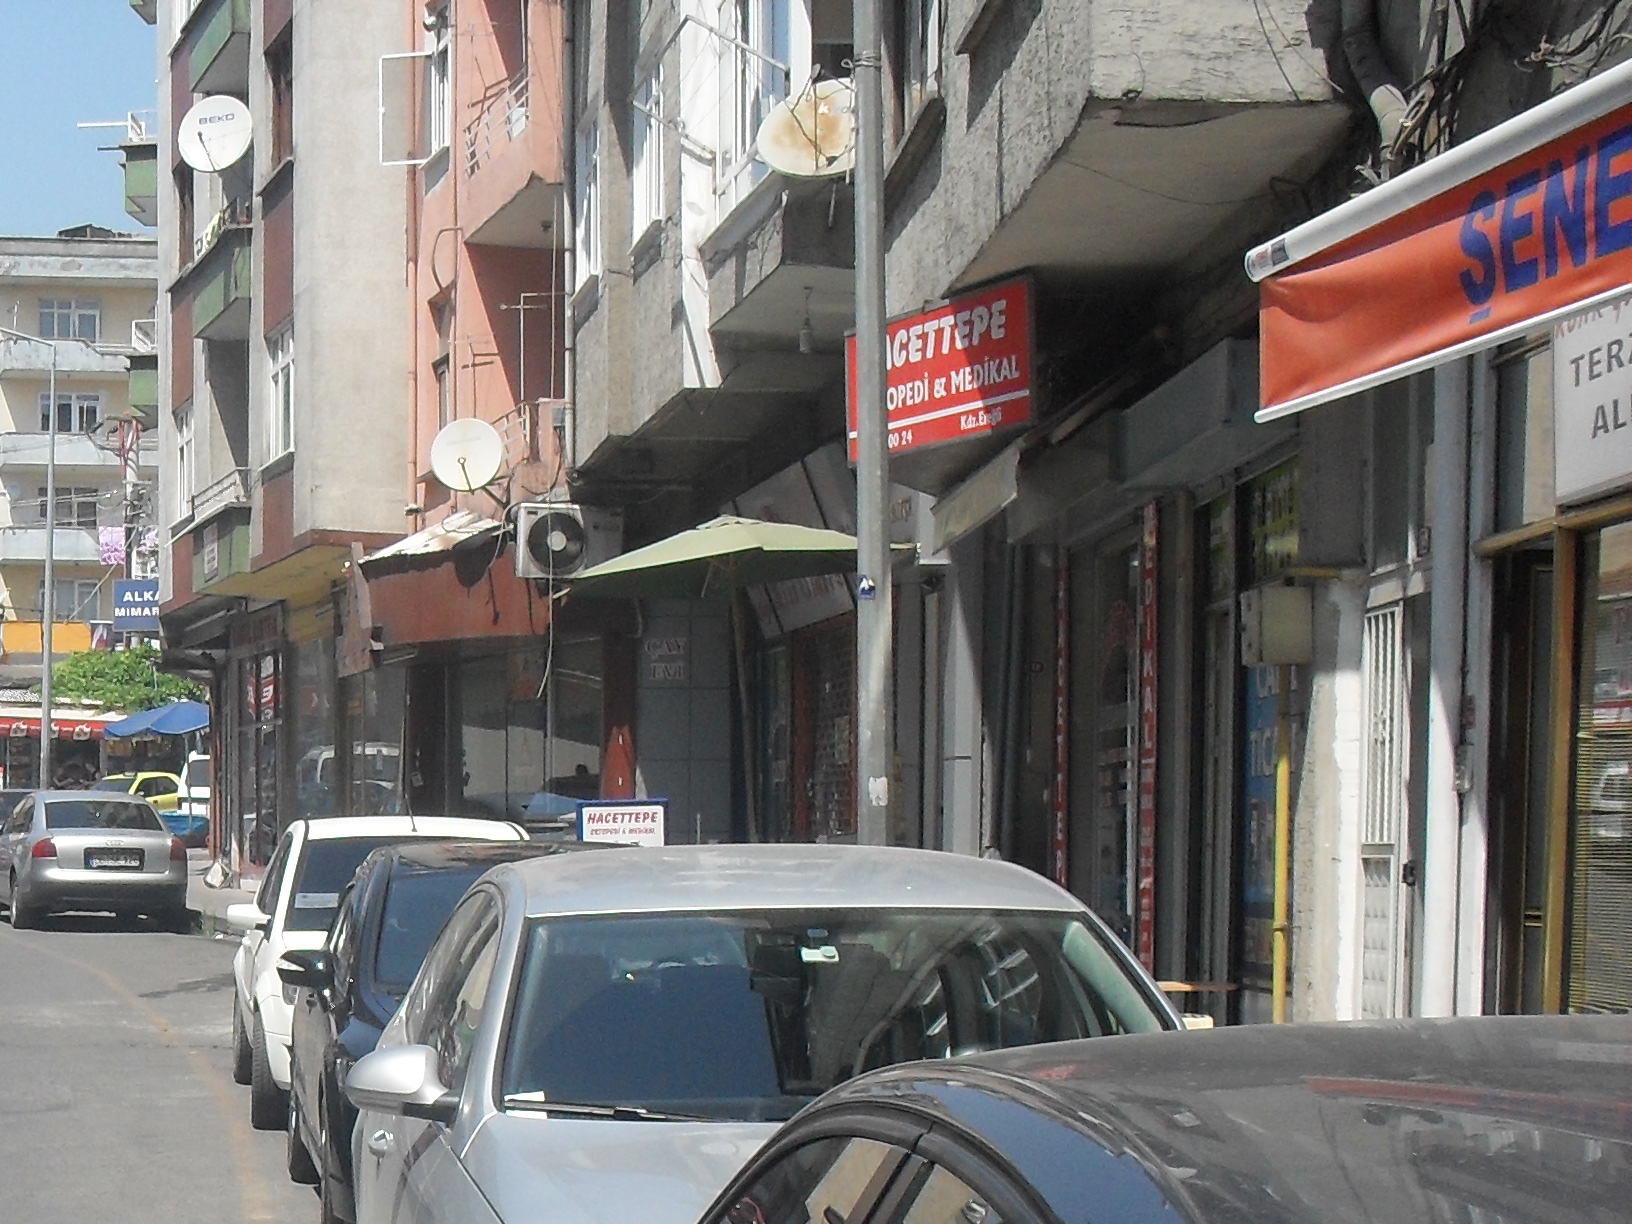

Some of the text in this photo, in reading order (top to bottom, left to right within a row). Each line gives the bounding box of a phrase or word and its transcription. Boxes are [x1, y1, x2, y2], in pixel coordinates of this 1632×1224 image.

[199, 113, 235, 125] BEKO
[1570, 331, 1632, 388] TER
[950, 354, 1019, 395] MEDİKAL
[1591, 393, 1632, 440] AL
[901, 429, 913, 446] 24
[587, 811, 658, 825] HACETTEPE
